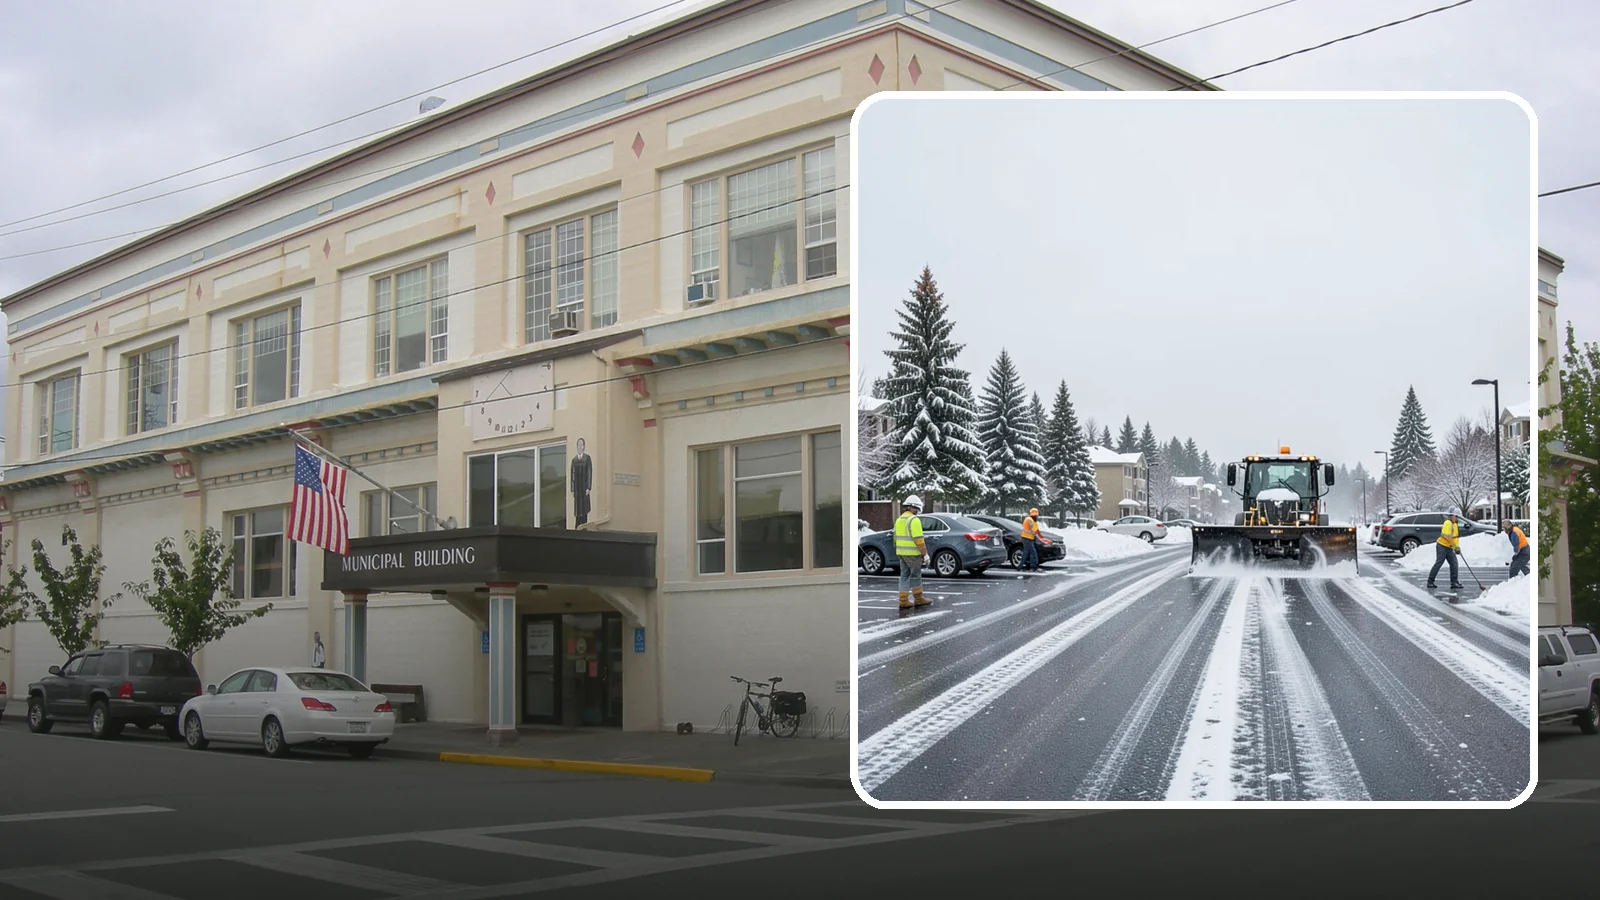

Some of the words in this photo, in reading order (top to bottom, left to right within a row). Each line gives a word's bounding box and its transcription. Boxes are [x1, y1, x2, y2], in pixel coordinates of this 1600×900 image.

[481, 407, 485, 415] 8
[488, 418, 492, 426] 9
[501, 425, 506, 433] 11
[507, 425, 513, 433] 12
[521, 420, 526, 428] 2
[529, 414, 533, 422] 3
[536, 402, 540, 410] 4
[342, 552, 405, 572] MUNICIPAL
[414, 546, 475, 567] BUILDING
